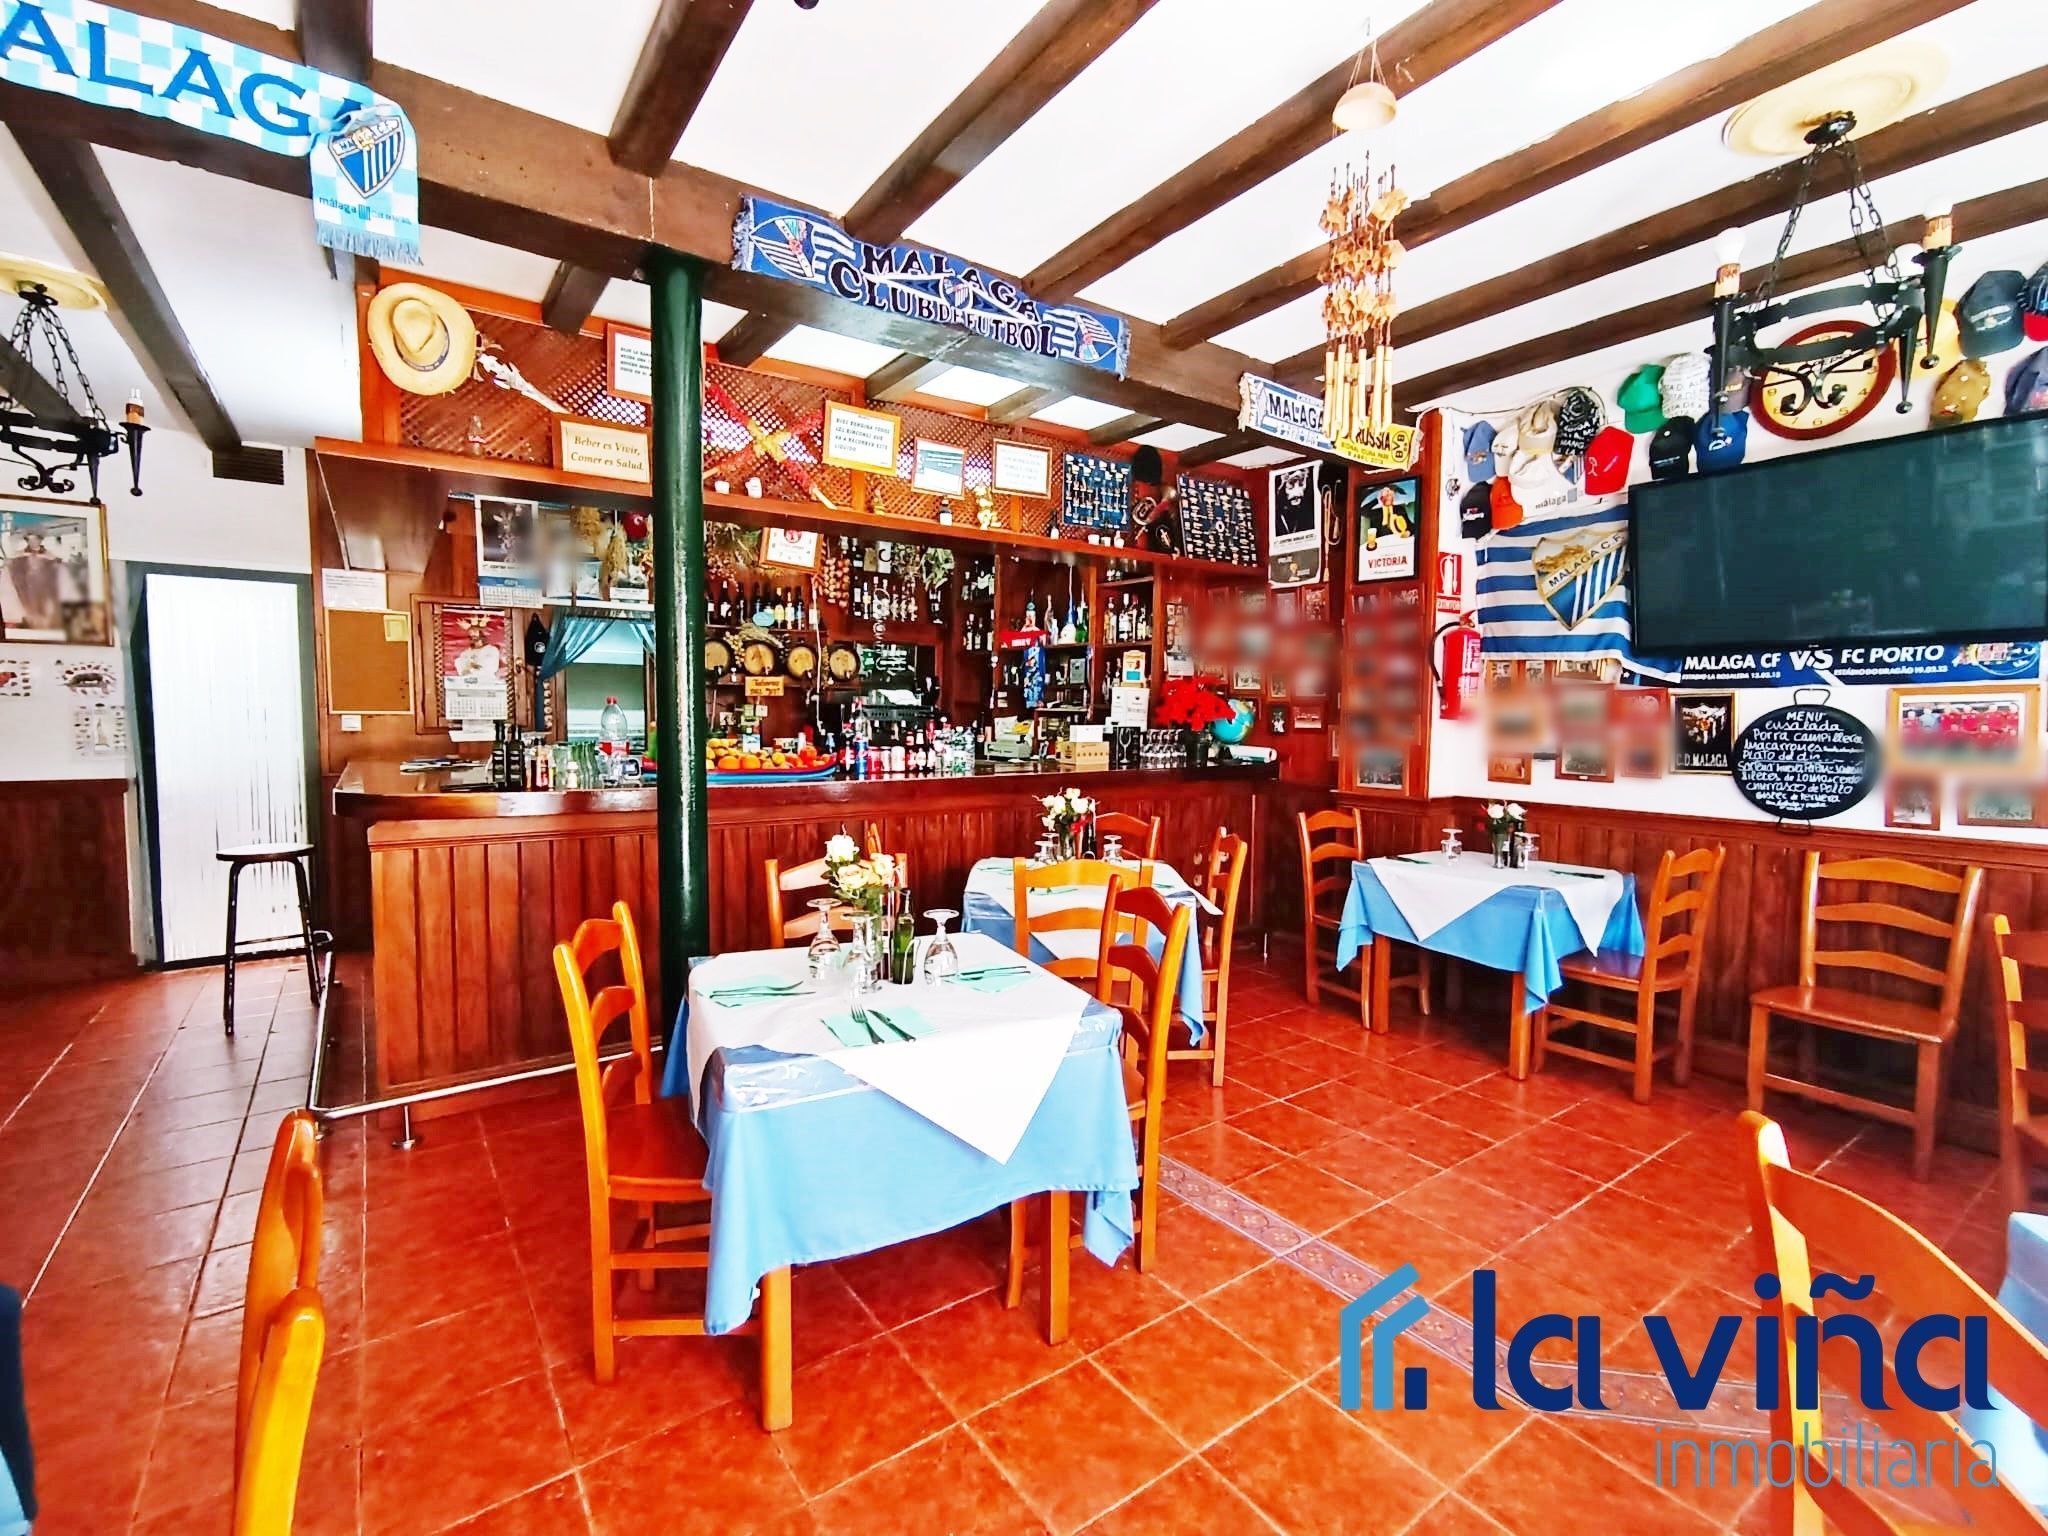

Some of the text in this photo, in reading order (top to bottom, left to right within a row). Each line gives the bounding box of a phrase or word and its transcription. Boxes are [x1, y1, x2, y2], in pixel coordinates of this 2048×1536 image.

[0, 0, 366, 138] ALAG
[862, 243, 1042, 325] MALAGA
[829, 259, 934, 320] CLUB
[966, 309, 1060, 358] FUTBOL
[574, 435, 640, 456] Beber es Vivir,
[1341, 427, 1391, 452] RUSSIA
[571, 451, 602, 464] Comer
[1368, 555, 1408, 568] VICTORIA
[1548, 549, 1600, 587] MALAGA
[1684, 653, 1756, 670] MALAGA
[1760, 652, 1782, 669] CF
[1789, 649, 1834, 671] VS
[1840, 649, 1866, 664] FC
[1869, 645, 1945, 663] PORTO
